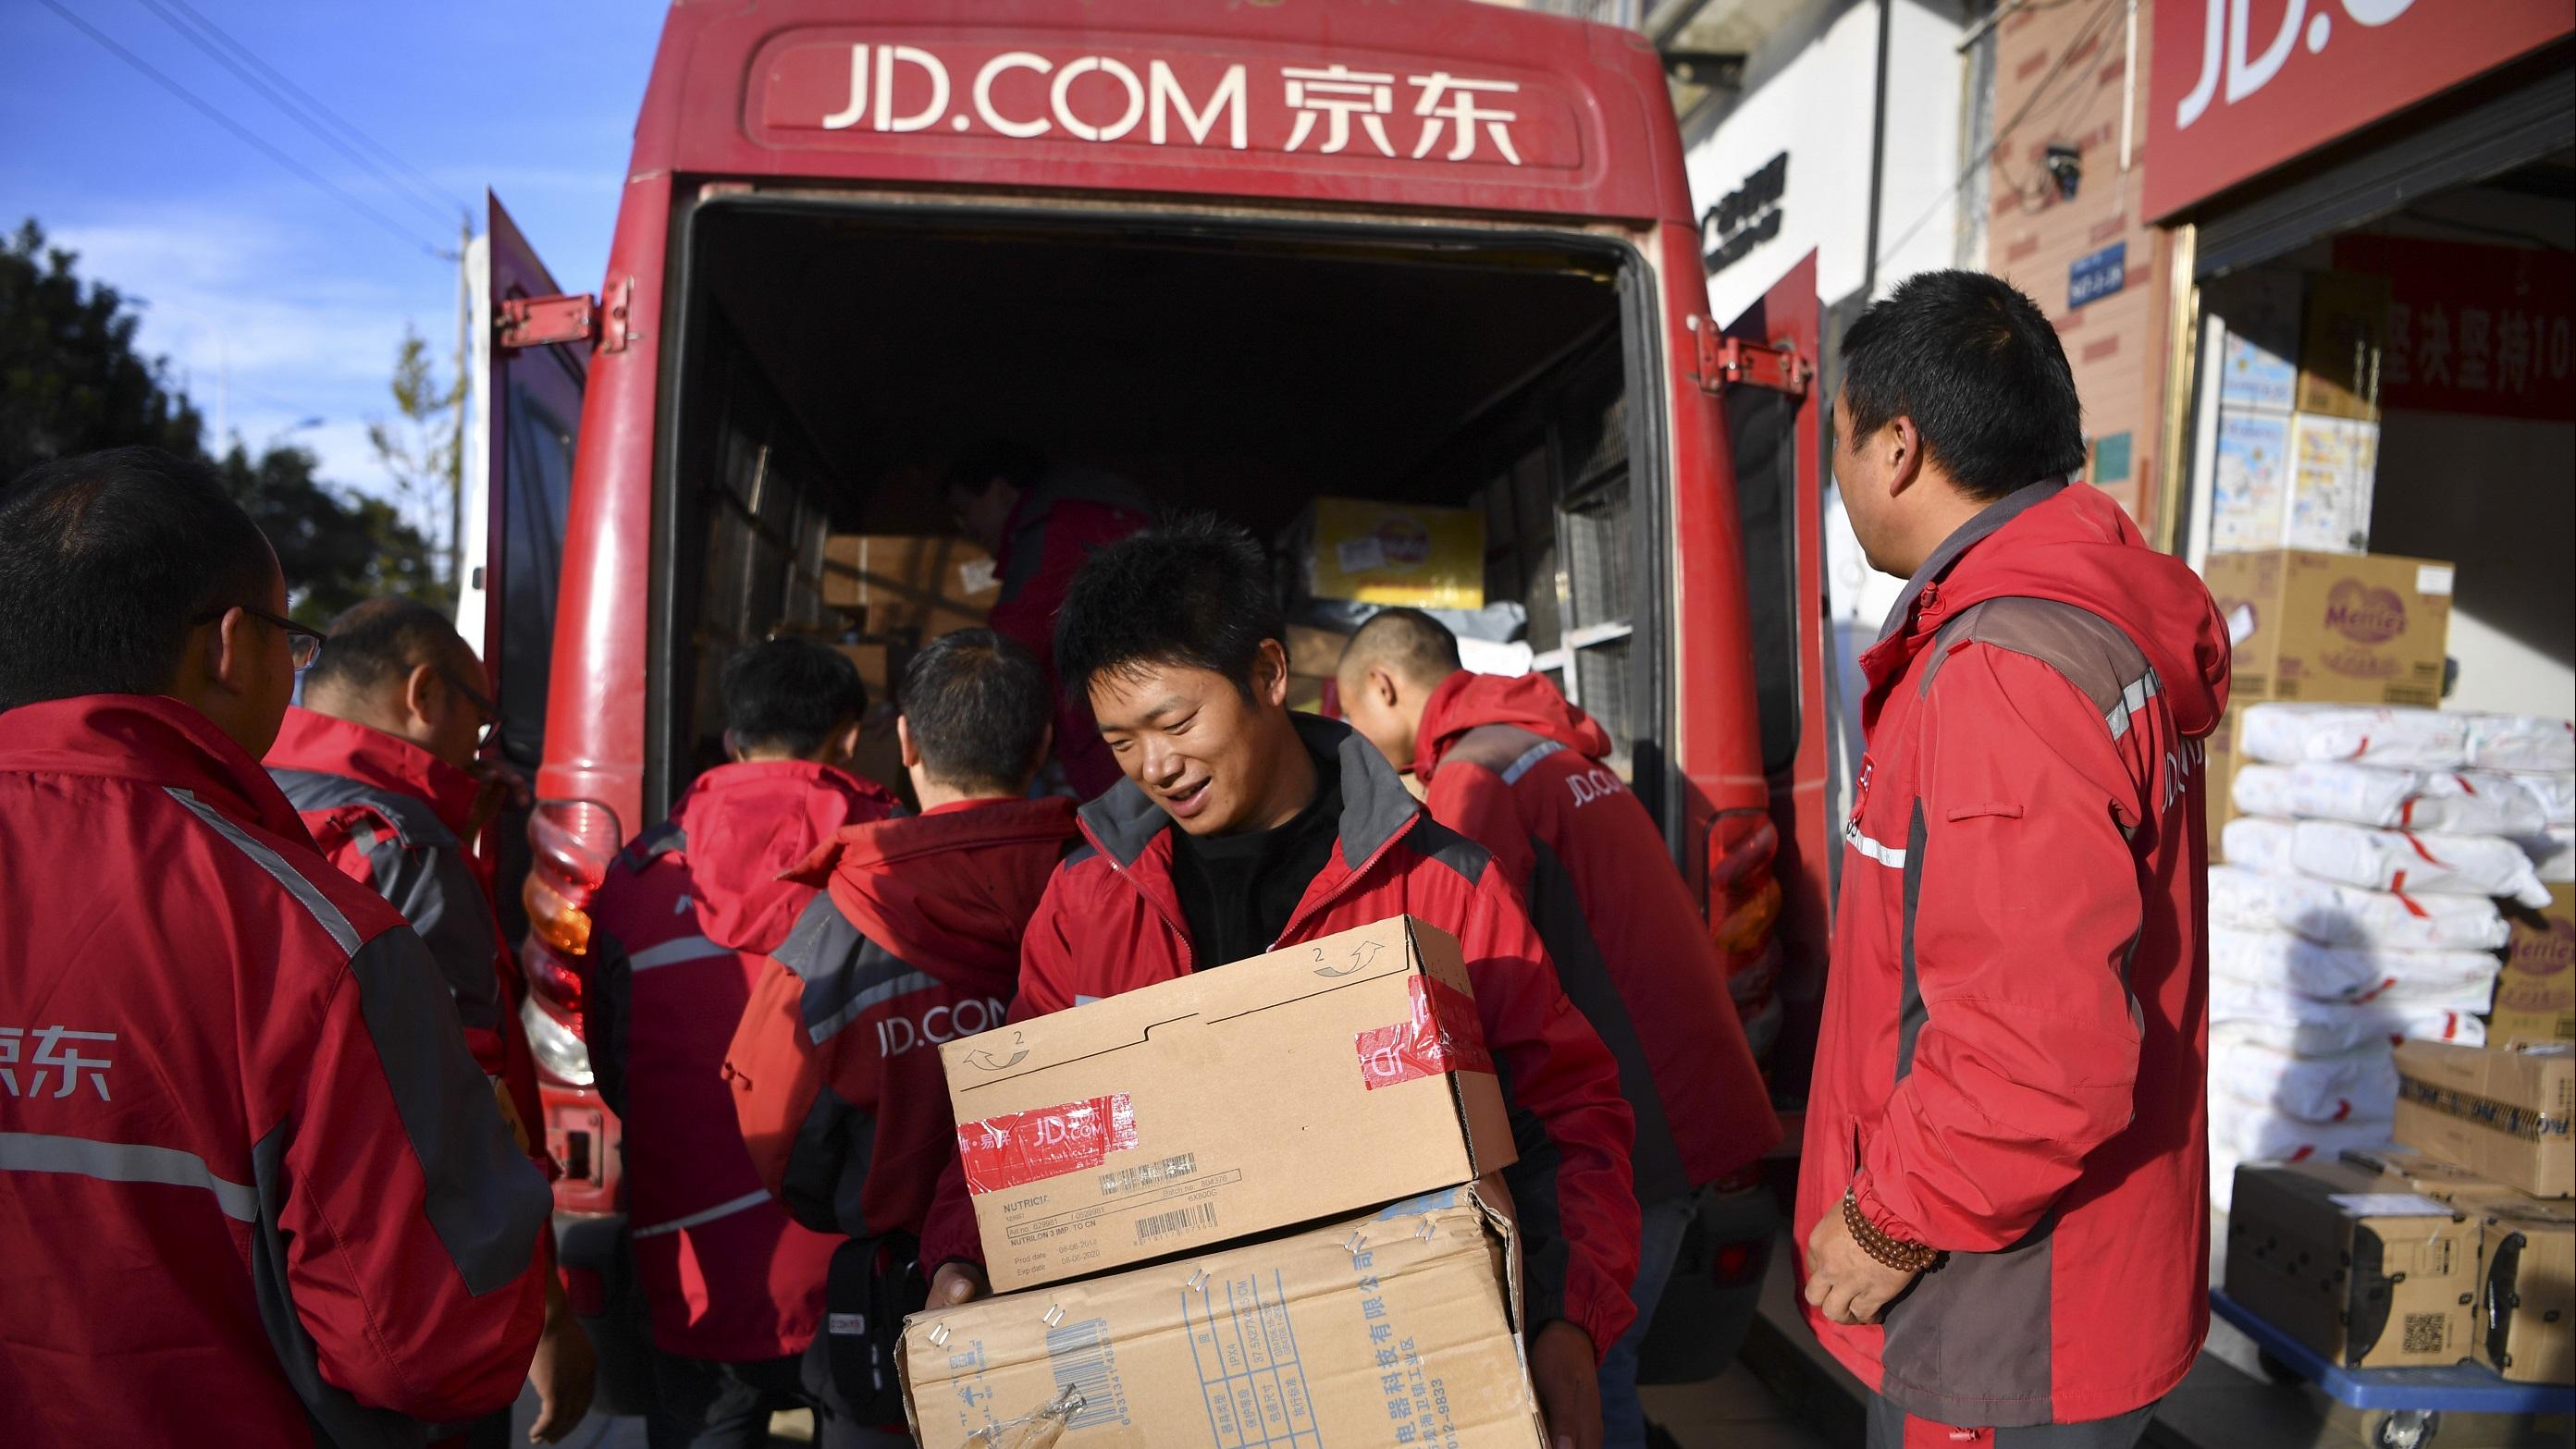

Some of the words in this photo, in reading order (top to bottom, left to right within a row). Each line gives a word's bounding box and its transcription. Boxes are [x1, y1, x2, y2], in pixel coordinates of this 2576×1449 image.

[2176, 0, 2416, 129] JD.
[823, 44, 1247, 150] JD.COM
[1280, 65, 1522, 166] 京东
[1313, 948, 1324, 963] 2
[1014, 1031, 1024, 1044] 2
[1011, 1231, 1049, 1247] NUTRILON
[1050, 1229, 1054, 1237] 3
[1073, 1222, 1084, 1231] TO
[1084, 1220, 1096, 1229] CN
[1014, 1256, 1030, 1265] Prod
[1032, 1251, 1047, 1262] date
[1017, 1268, 1030, 1277] Exp
[1031, 1264, 1046, 1273] date
[1227, 1344, 1241, 1367] IPX4
